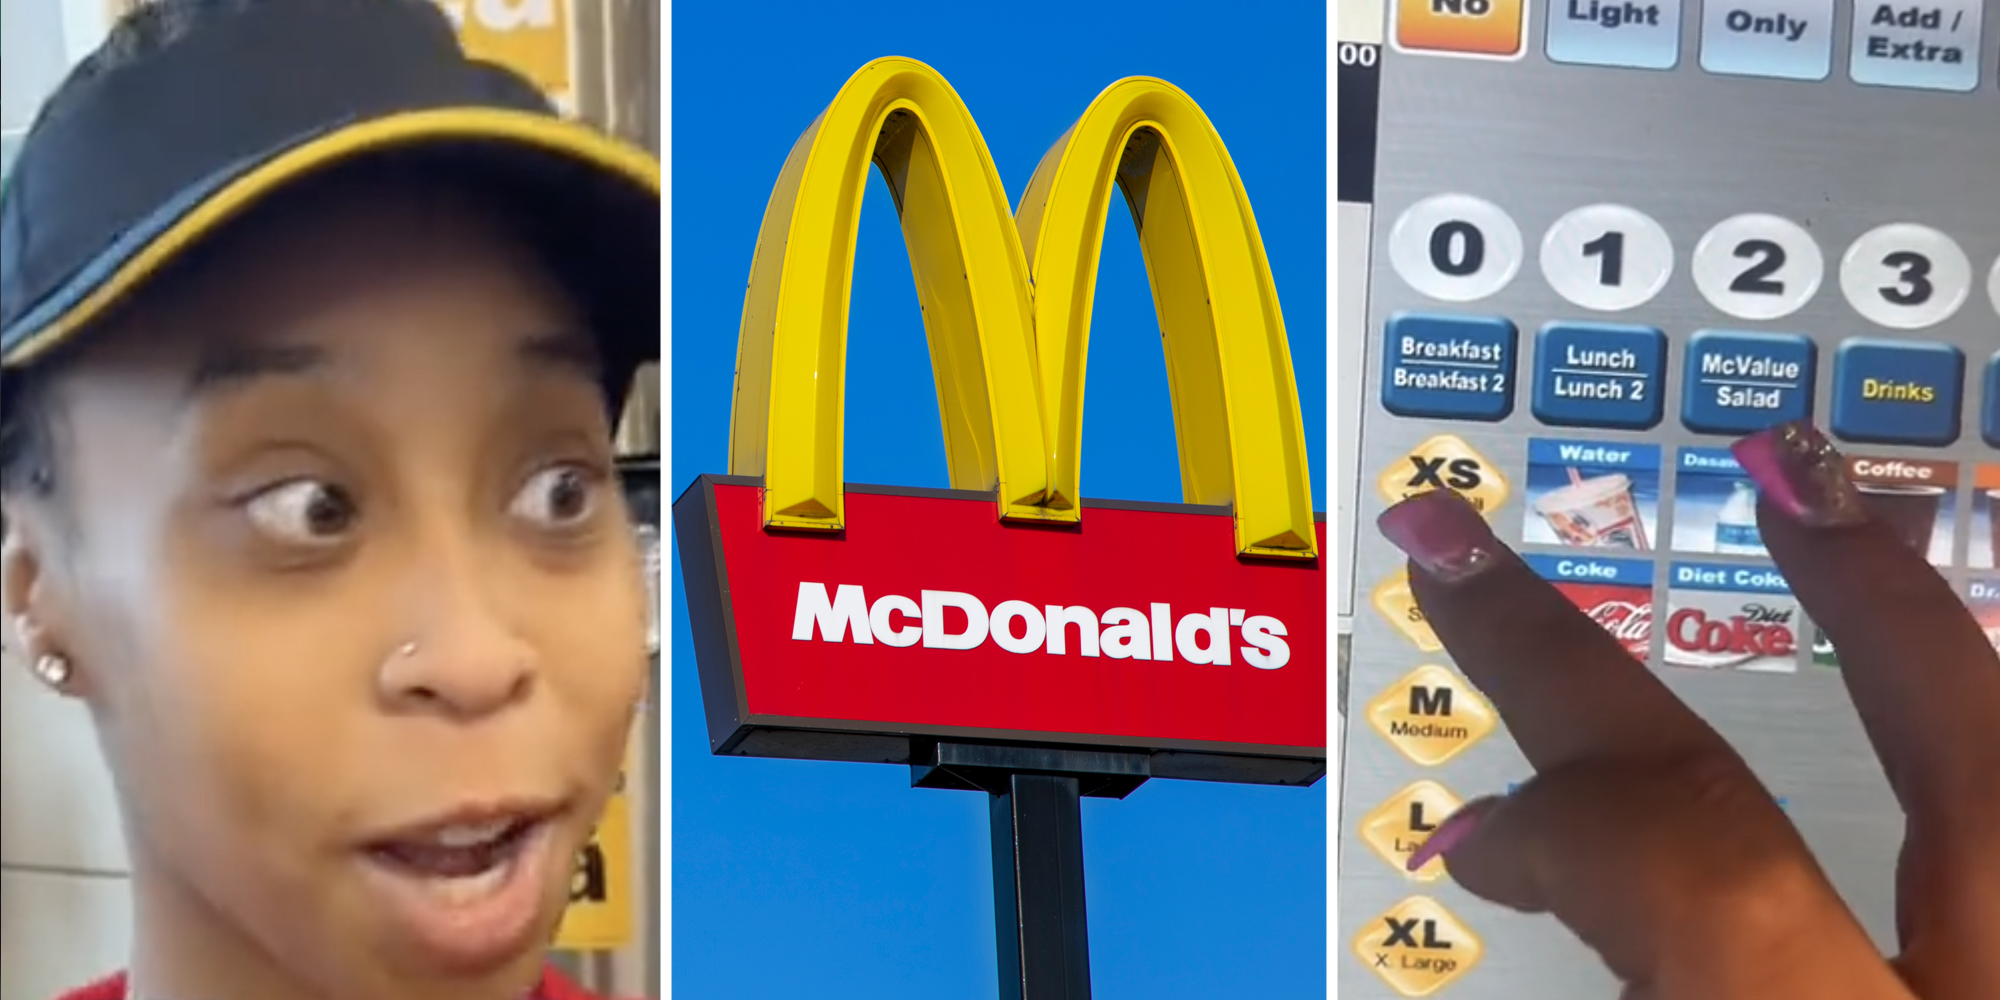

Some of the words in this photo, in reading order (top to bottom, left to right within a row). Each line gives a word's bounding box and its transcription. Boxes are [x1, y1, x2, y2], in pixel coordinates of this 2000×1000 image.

[1432, 0, 1490, 15] No
[1567, 0, 1660, 28] Light
[1871, 4, 1941, 30] Add
[1951, 10, 1963, 32] /
[1726, 10, 1807, 42] Only
[1866, 36, 1962, 64] Extra
[1429, 220, 1485, 277] 0
[1582, 231, 1625, 287] 1
[1728, 239, 1787, 296] 2
[1878, 251, 1934, 306] 3
[1402, 336, 1501, 361] Breakfast
[1566, 345, 1636, 369] Lunch
[1701, 353, 1800, 379] McValue
[1394, 368, 1487, 391] Breakfast
[1492, 373, 1505, 392] 2
[1554, 376, 1623, 399] Lunch
[1629, 381, 1645, 400] 2
[1862, 378, 1935, 402] Drinks
[1716, 386, 1780, 409] Salad
[1558, 444, 1632, 464] Water
[1684, 452, 1741, 468] Dasan
[1407, 455, 1482, 490] XS
[1853, 459, 1934, 480] Coffee
[1556, 560, 1618, 578] Coke
[1677, 566, 1727, 586] Diet
[790, 580, 1292, 671] McDonald's
[1741, 603, 1794, 625] Diet
[1666, 606, 1798, 658] Coke
[1408, 685, 1453, 718] M
[1390, 721, 1468, 740] Medium
[1409, 802, 1437, 833] L
[1381, 916, 1452, 950] XL
[1401, 955, 1457, 974] Large
